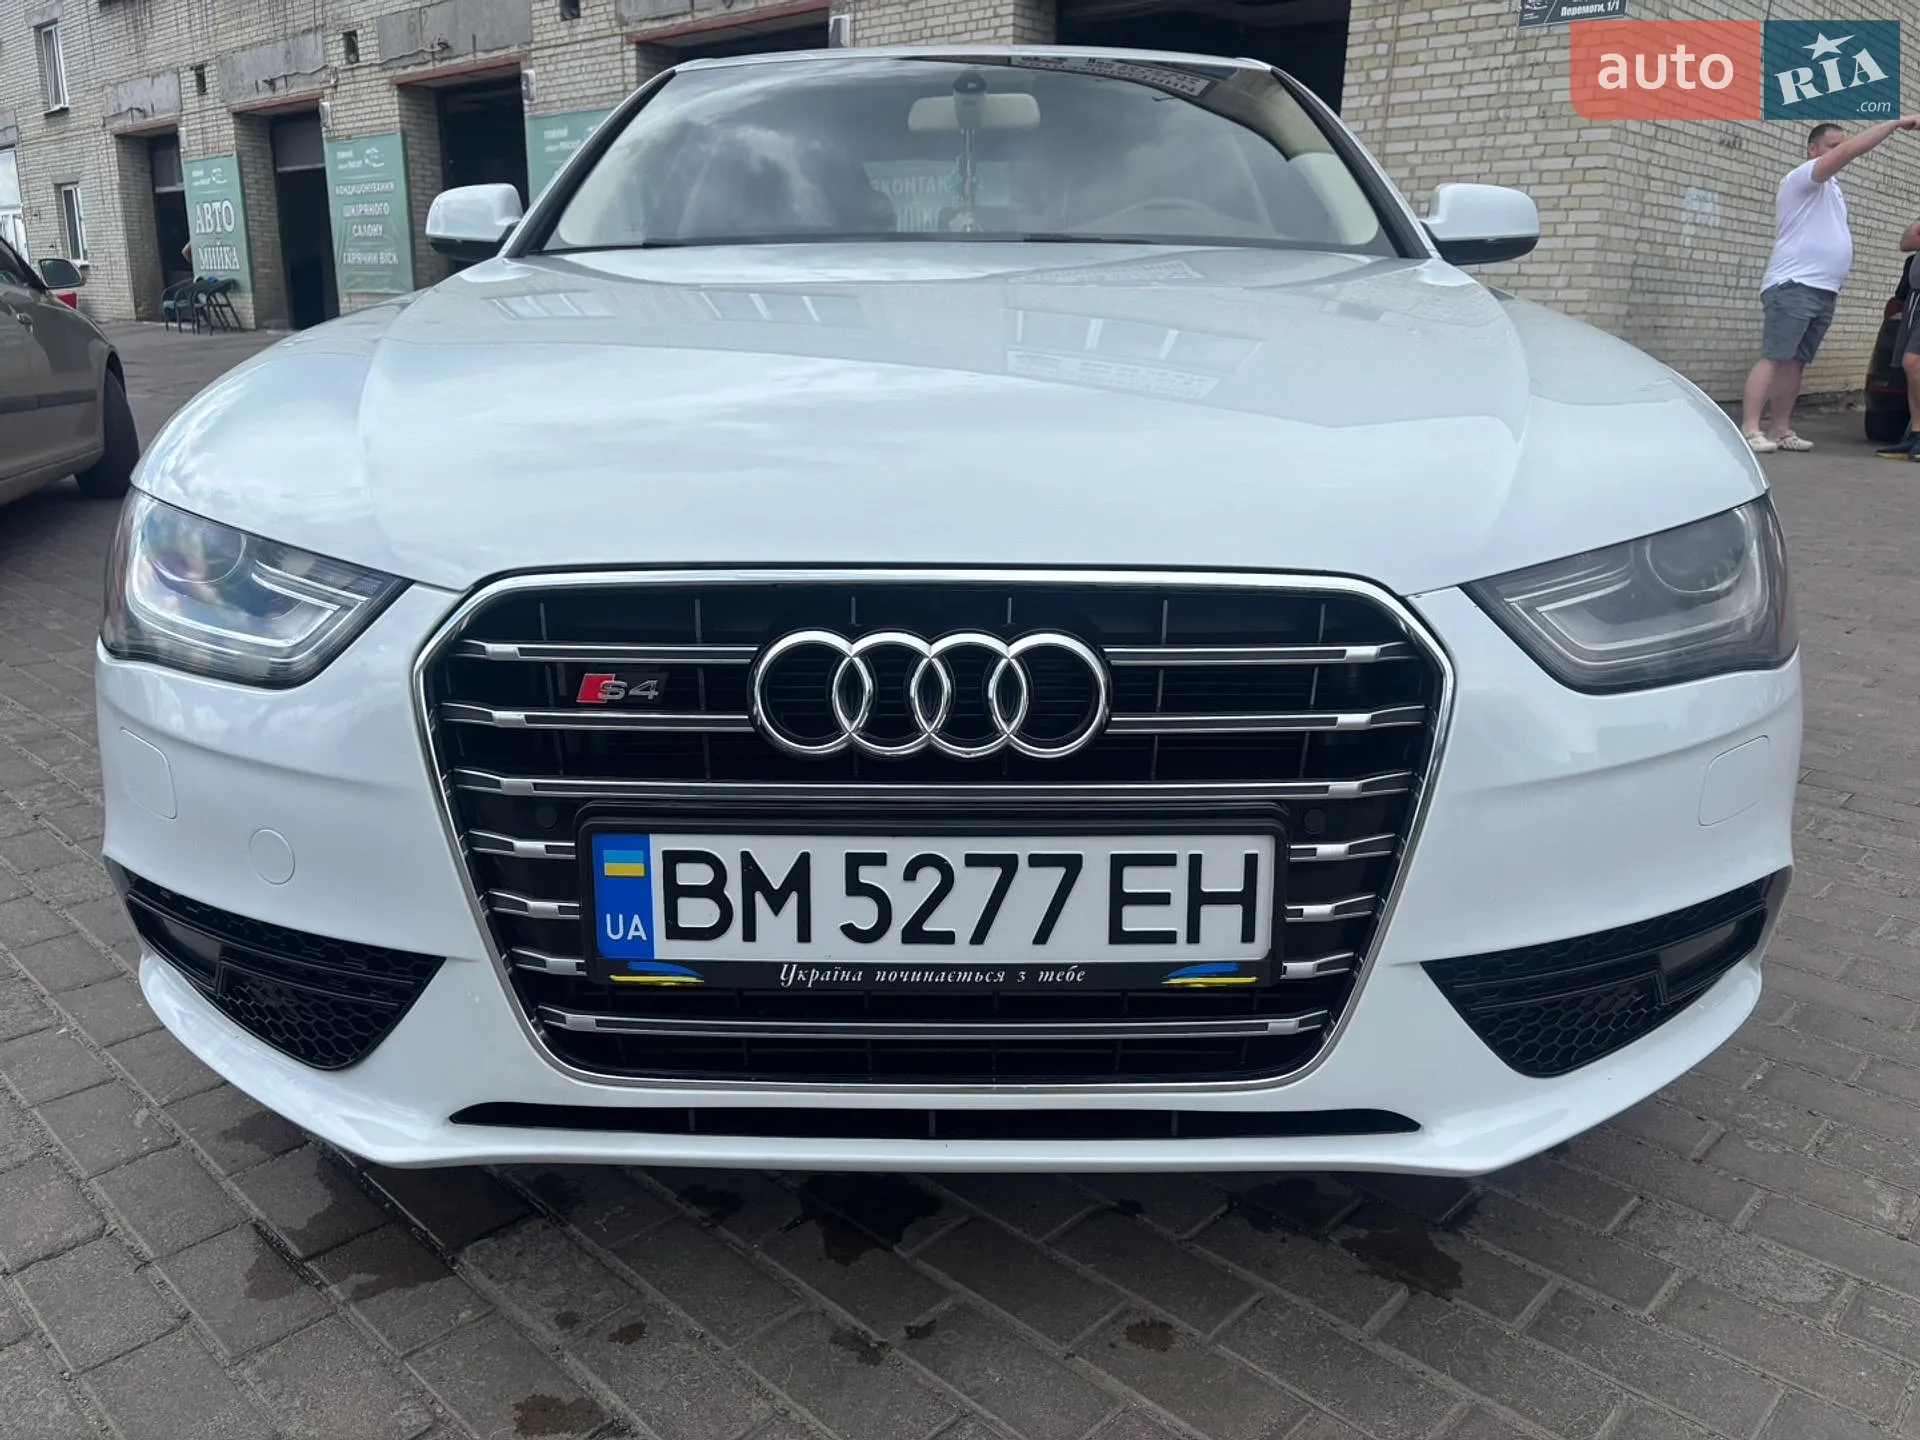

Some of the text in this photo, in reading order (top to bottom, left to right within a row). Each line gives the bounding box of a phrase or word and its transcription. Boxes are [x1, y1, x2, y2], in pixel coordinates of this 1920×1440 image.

[195, 200, 235, 233] АВТО
[352, 223, 383, 237] САЛОНУ
[199, 239, 240, 271] МИЙКА
[597, 679, 660, 700] S4
[661, 849, 1259, 945] BM 5277 EH
[605, 912, 648, 941] UA
[780, 963, 1086, 988] Україна починається з тебе
